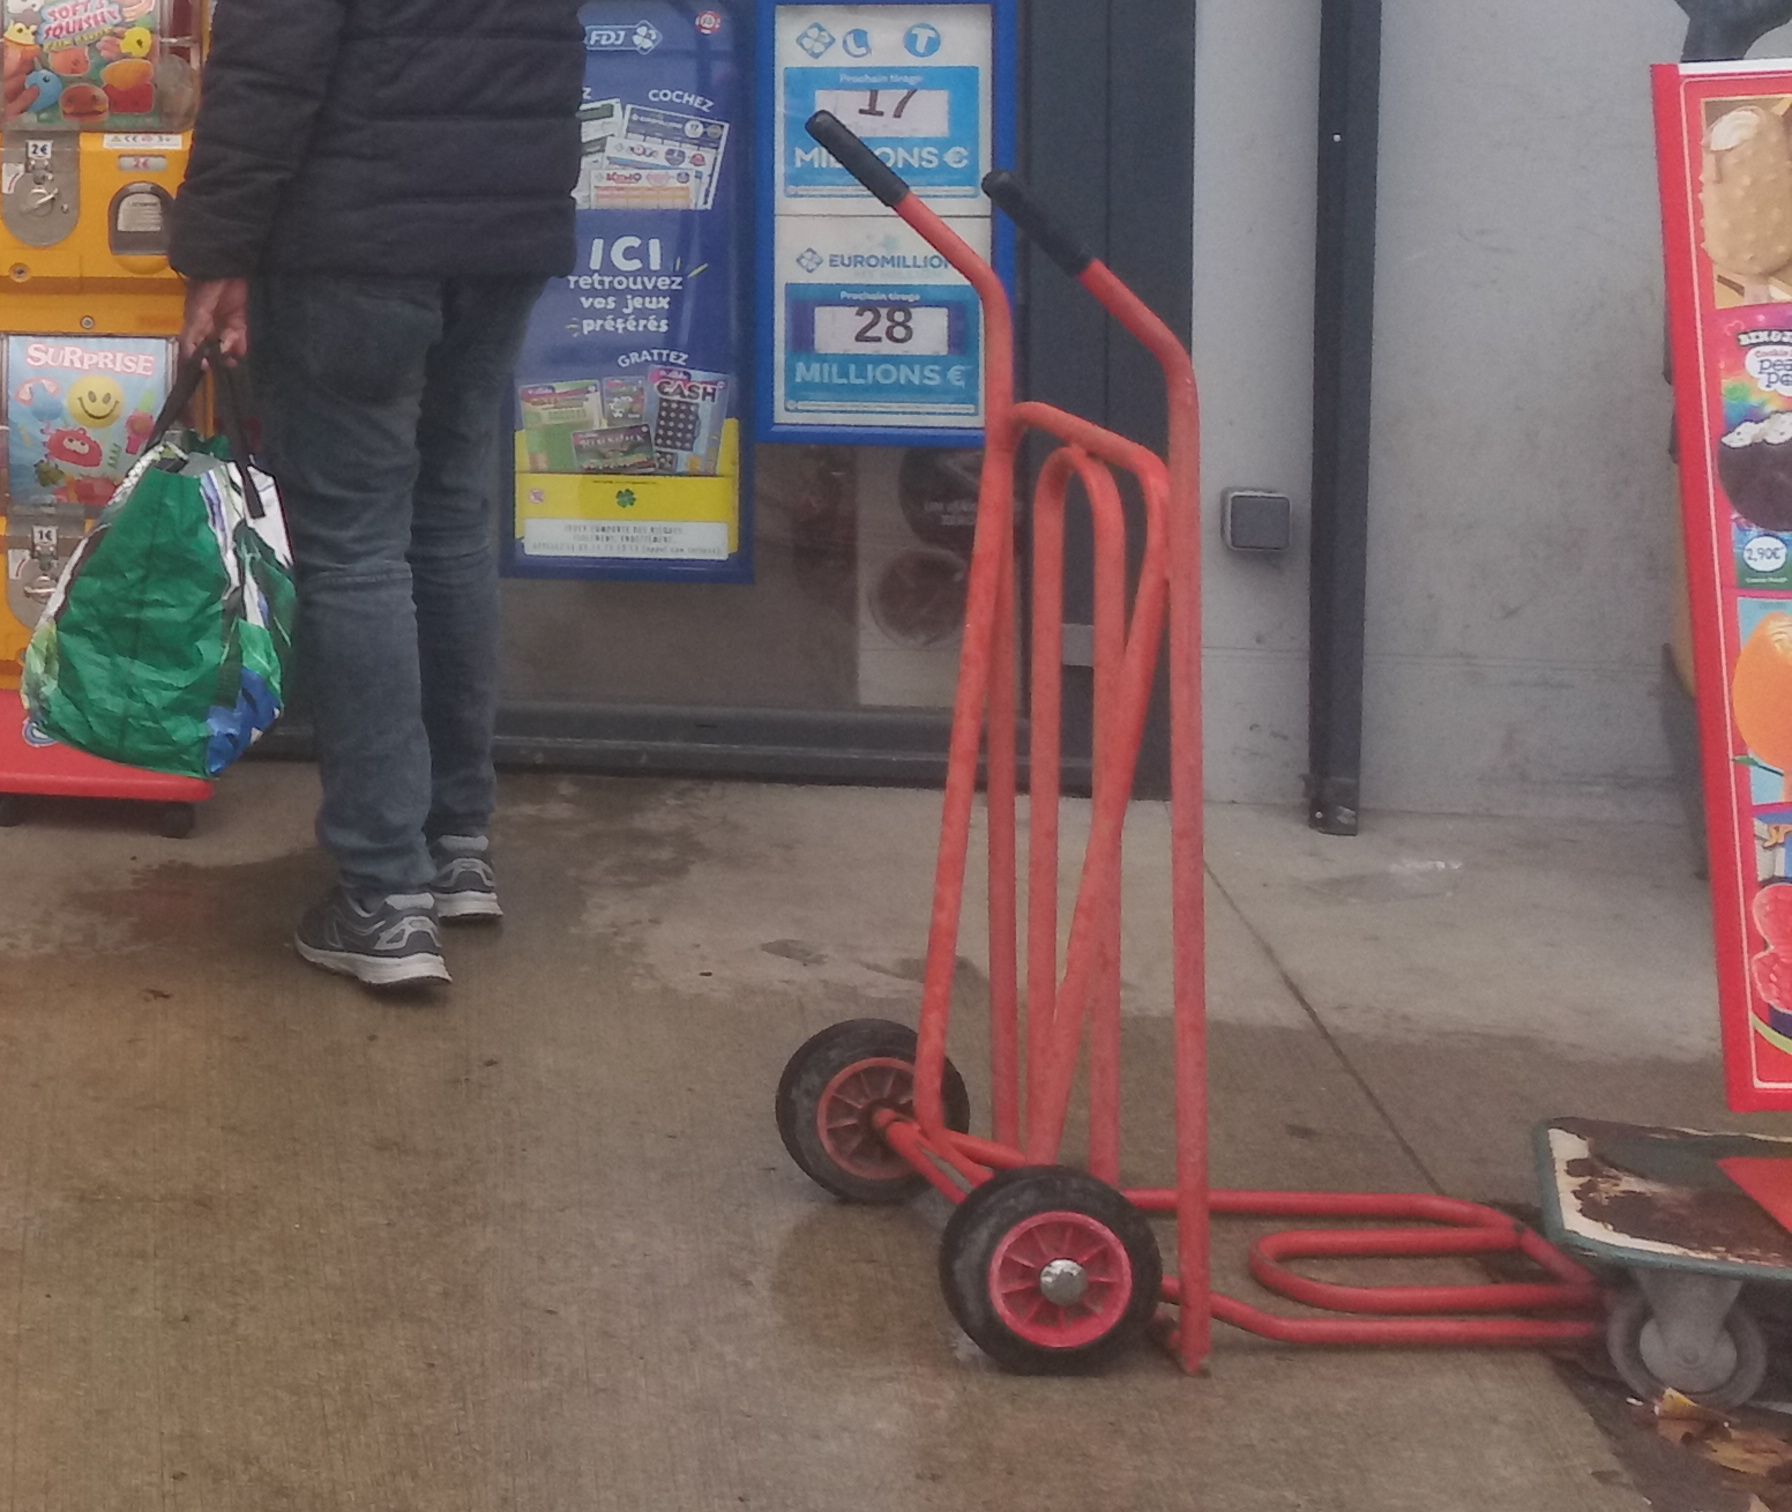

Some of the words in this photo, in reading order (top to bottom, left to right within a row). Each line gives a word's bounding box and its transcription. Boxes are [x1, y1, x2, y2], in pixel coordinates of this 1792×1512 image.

[590, 30, 625, 45] FDJ
[648, 89, 714, 112] COCHEZ
[795, 147, 939, 168] MILONS
[589, 236, 661, 271] ICI
[829, 254, 949, 269] EUROMILLIO
[567, 273, 683, 289] retrouvez
[580, 296, 616, 309] vos
[622, 294, 671, 314] jeux
[582, 315, 669, 335] préférés
[854, 307, 913, 343] 28
[618, 349, 689, 367] GRATTEZ
[795, 362, 942, 386] MILLIONS
[947, 364, 969, 387] €
[655, 379, 717, 403] CASH
